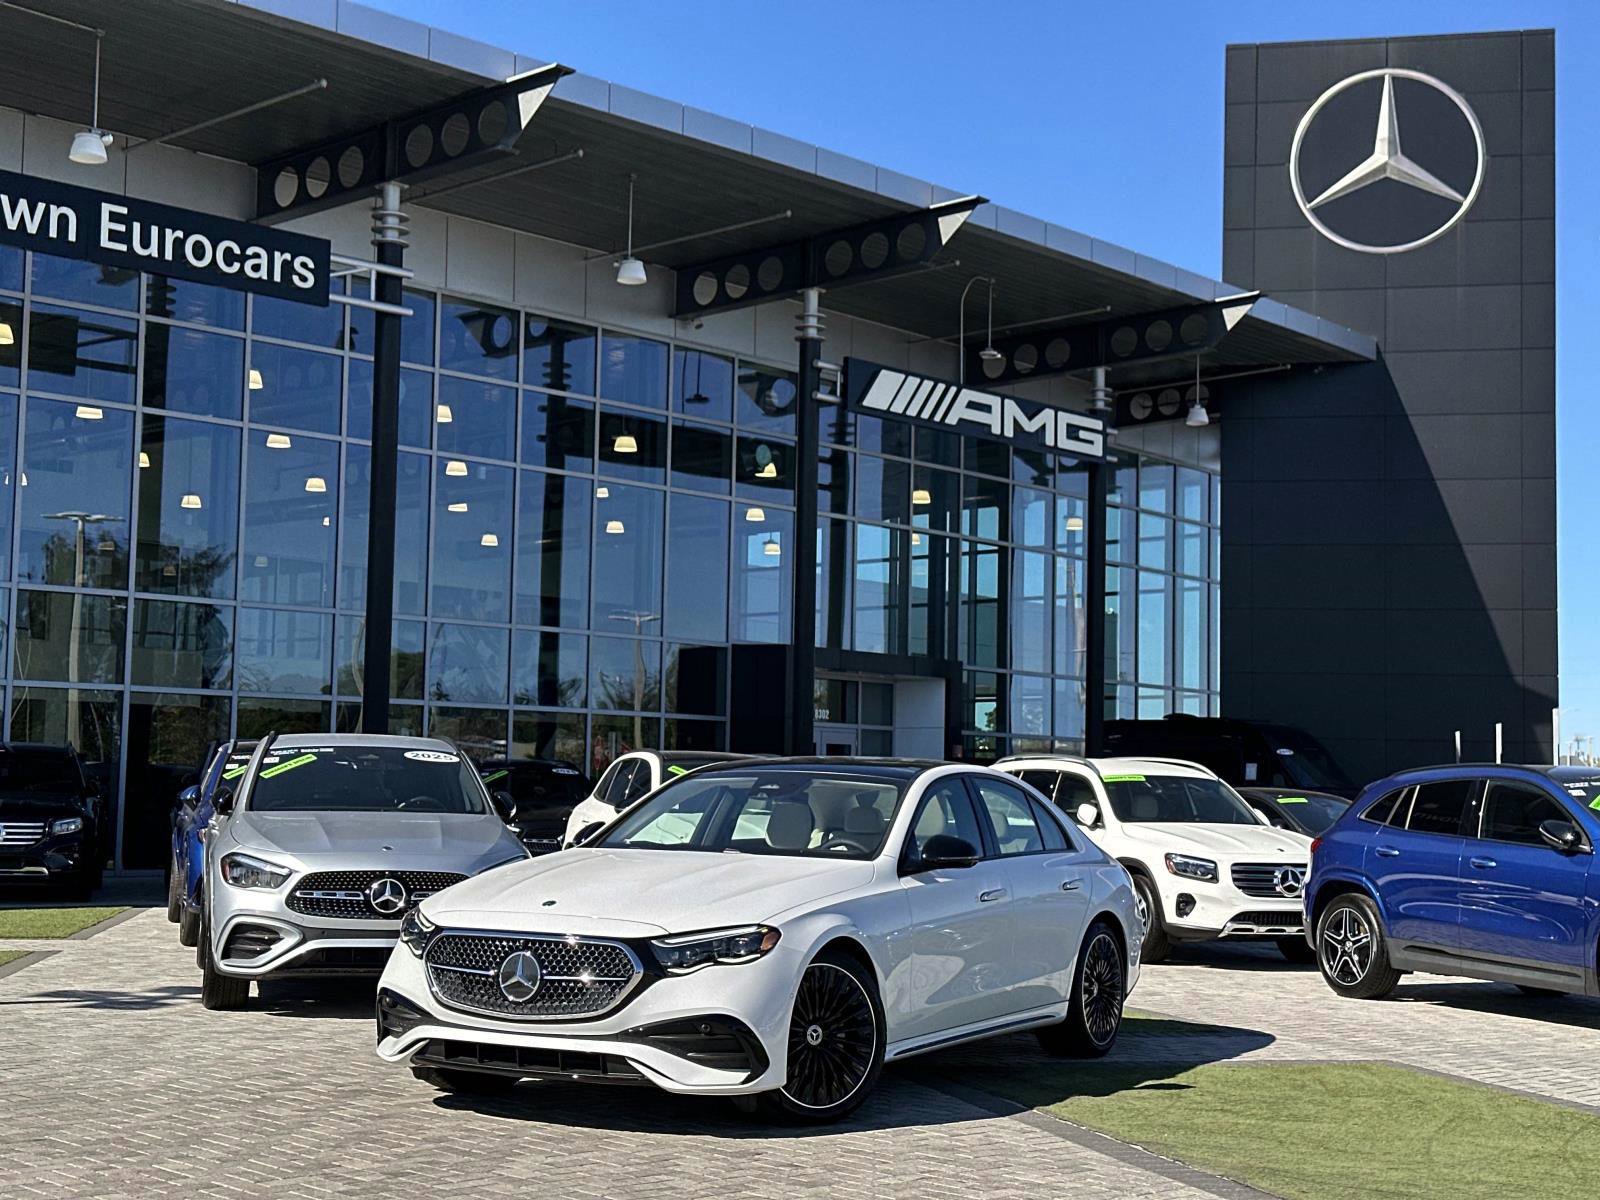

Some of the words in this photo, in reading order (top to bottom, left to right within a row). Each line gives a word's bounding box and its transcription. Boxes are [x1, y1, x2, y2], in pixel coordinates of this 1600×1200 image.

[100, 202, 315, 289] Eurocars
[945, 388, 1104, 457] AMG
[815, 709, 830, 720] 8302
[410, 752, 453, 761] 2025
